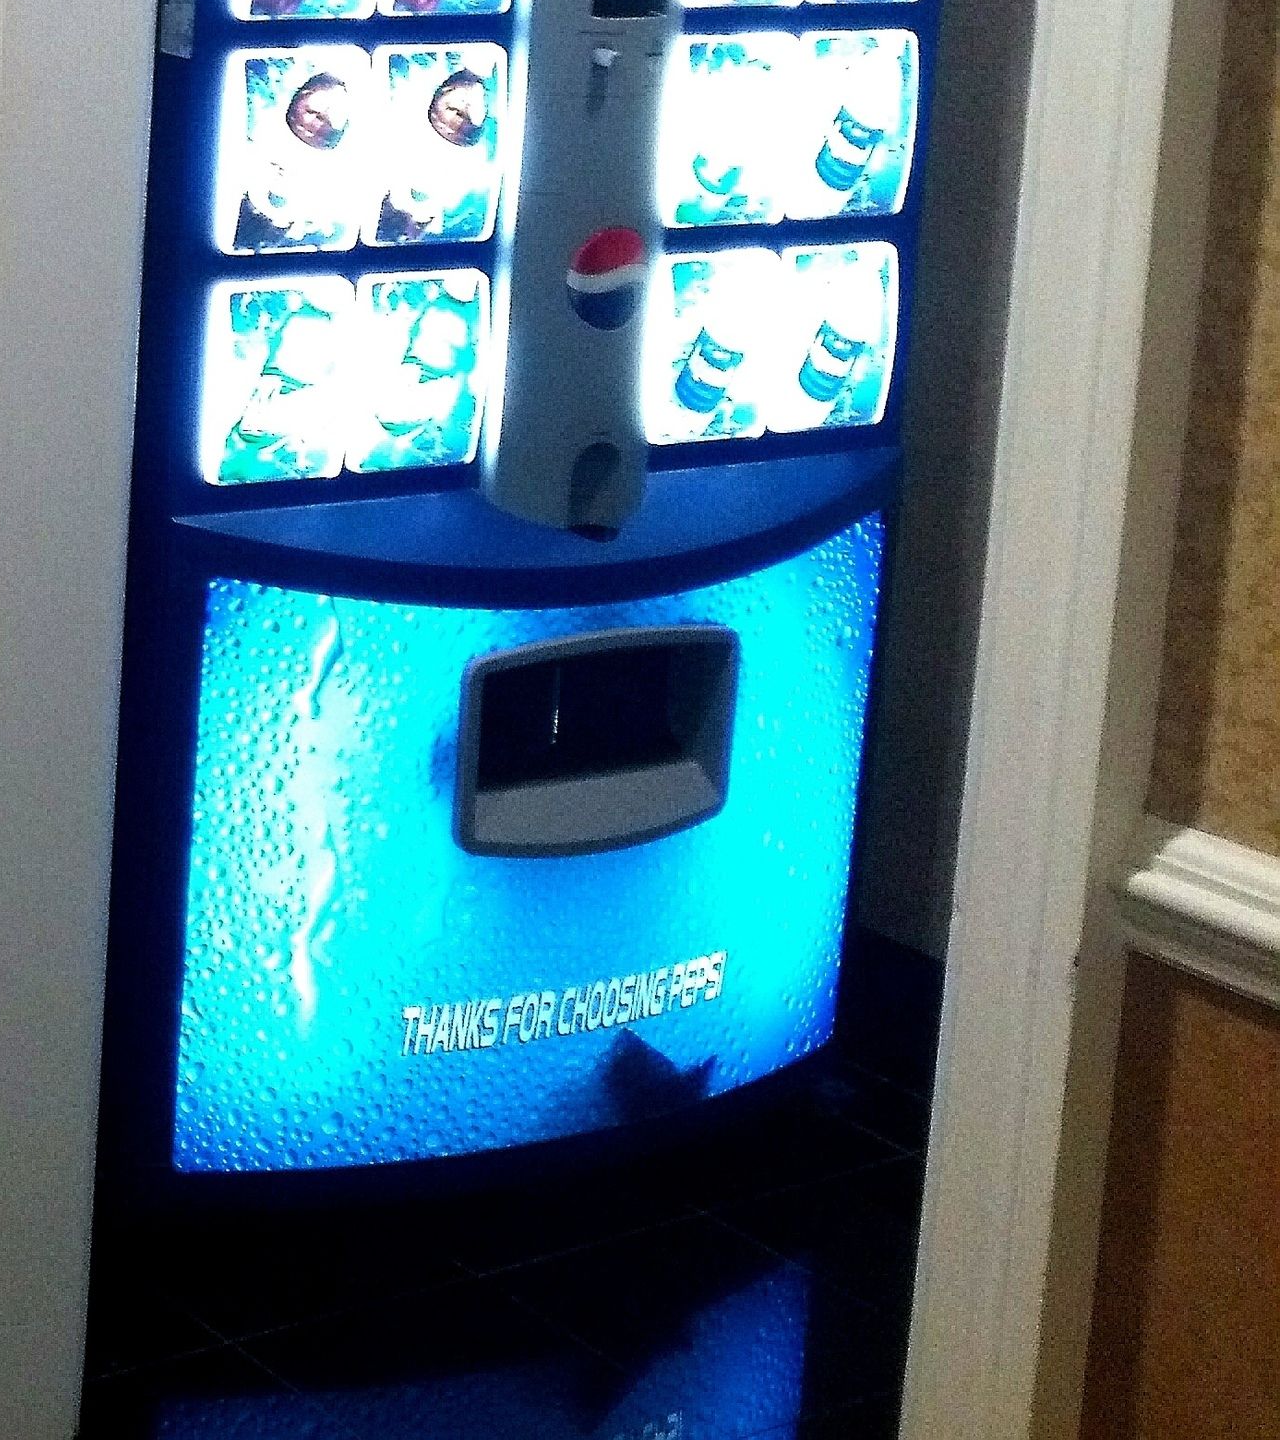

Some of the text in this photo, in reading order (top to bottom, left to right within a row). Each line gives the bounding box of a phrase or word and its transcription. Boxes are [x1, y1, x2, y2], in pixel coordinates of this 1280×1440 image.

[402, 950, 728, 1056] THANKS FOR CHOOSING PEPSI
